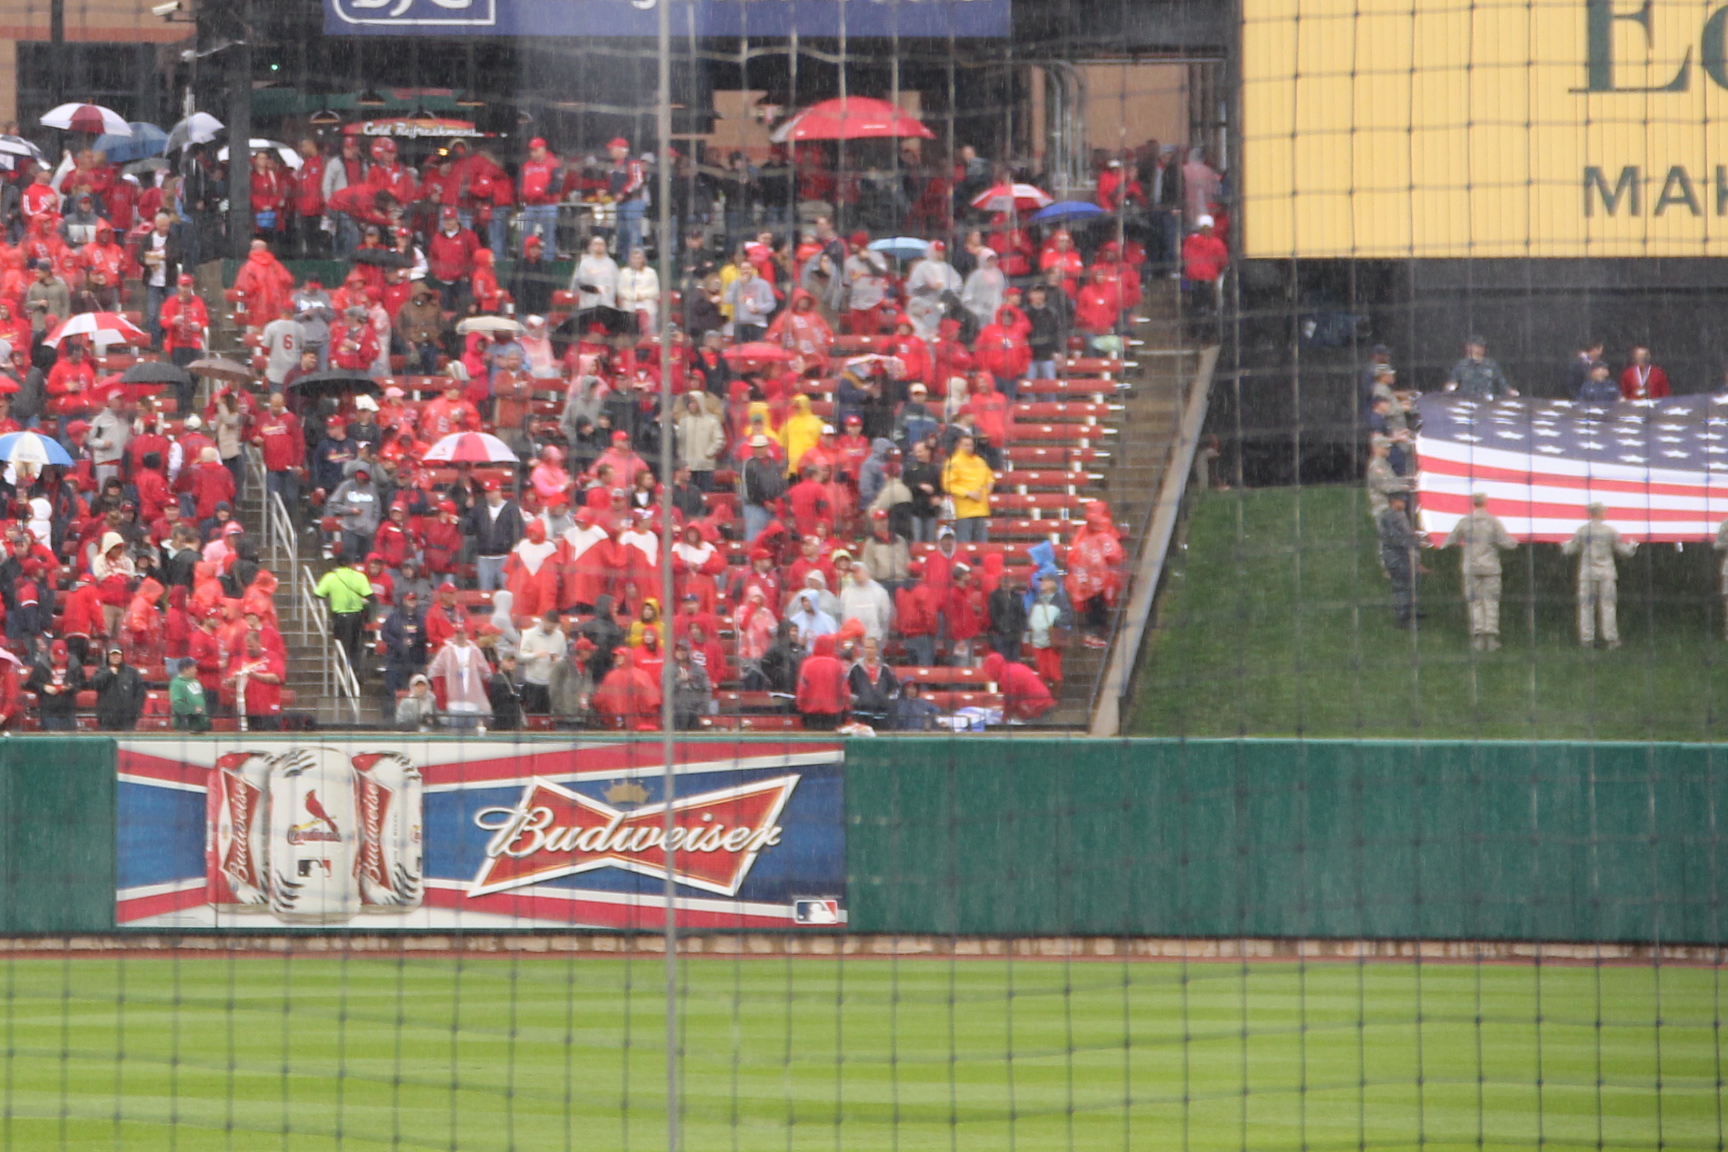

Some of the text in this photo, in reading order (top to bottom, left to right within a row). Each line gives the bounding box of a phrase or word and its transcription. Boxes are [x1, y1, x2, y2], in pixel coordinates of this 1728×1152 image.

[363, 122, 391, 136] Cold
[1584, 165, 1728, 217] MA
[283, 334, 294, 350] 6
[474, 806, 782, 858] Budweiser
